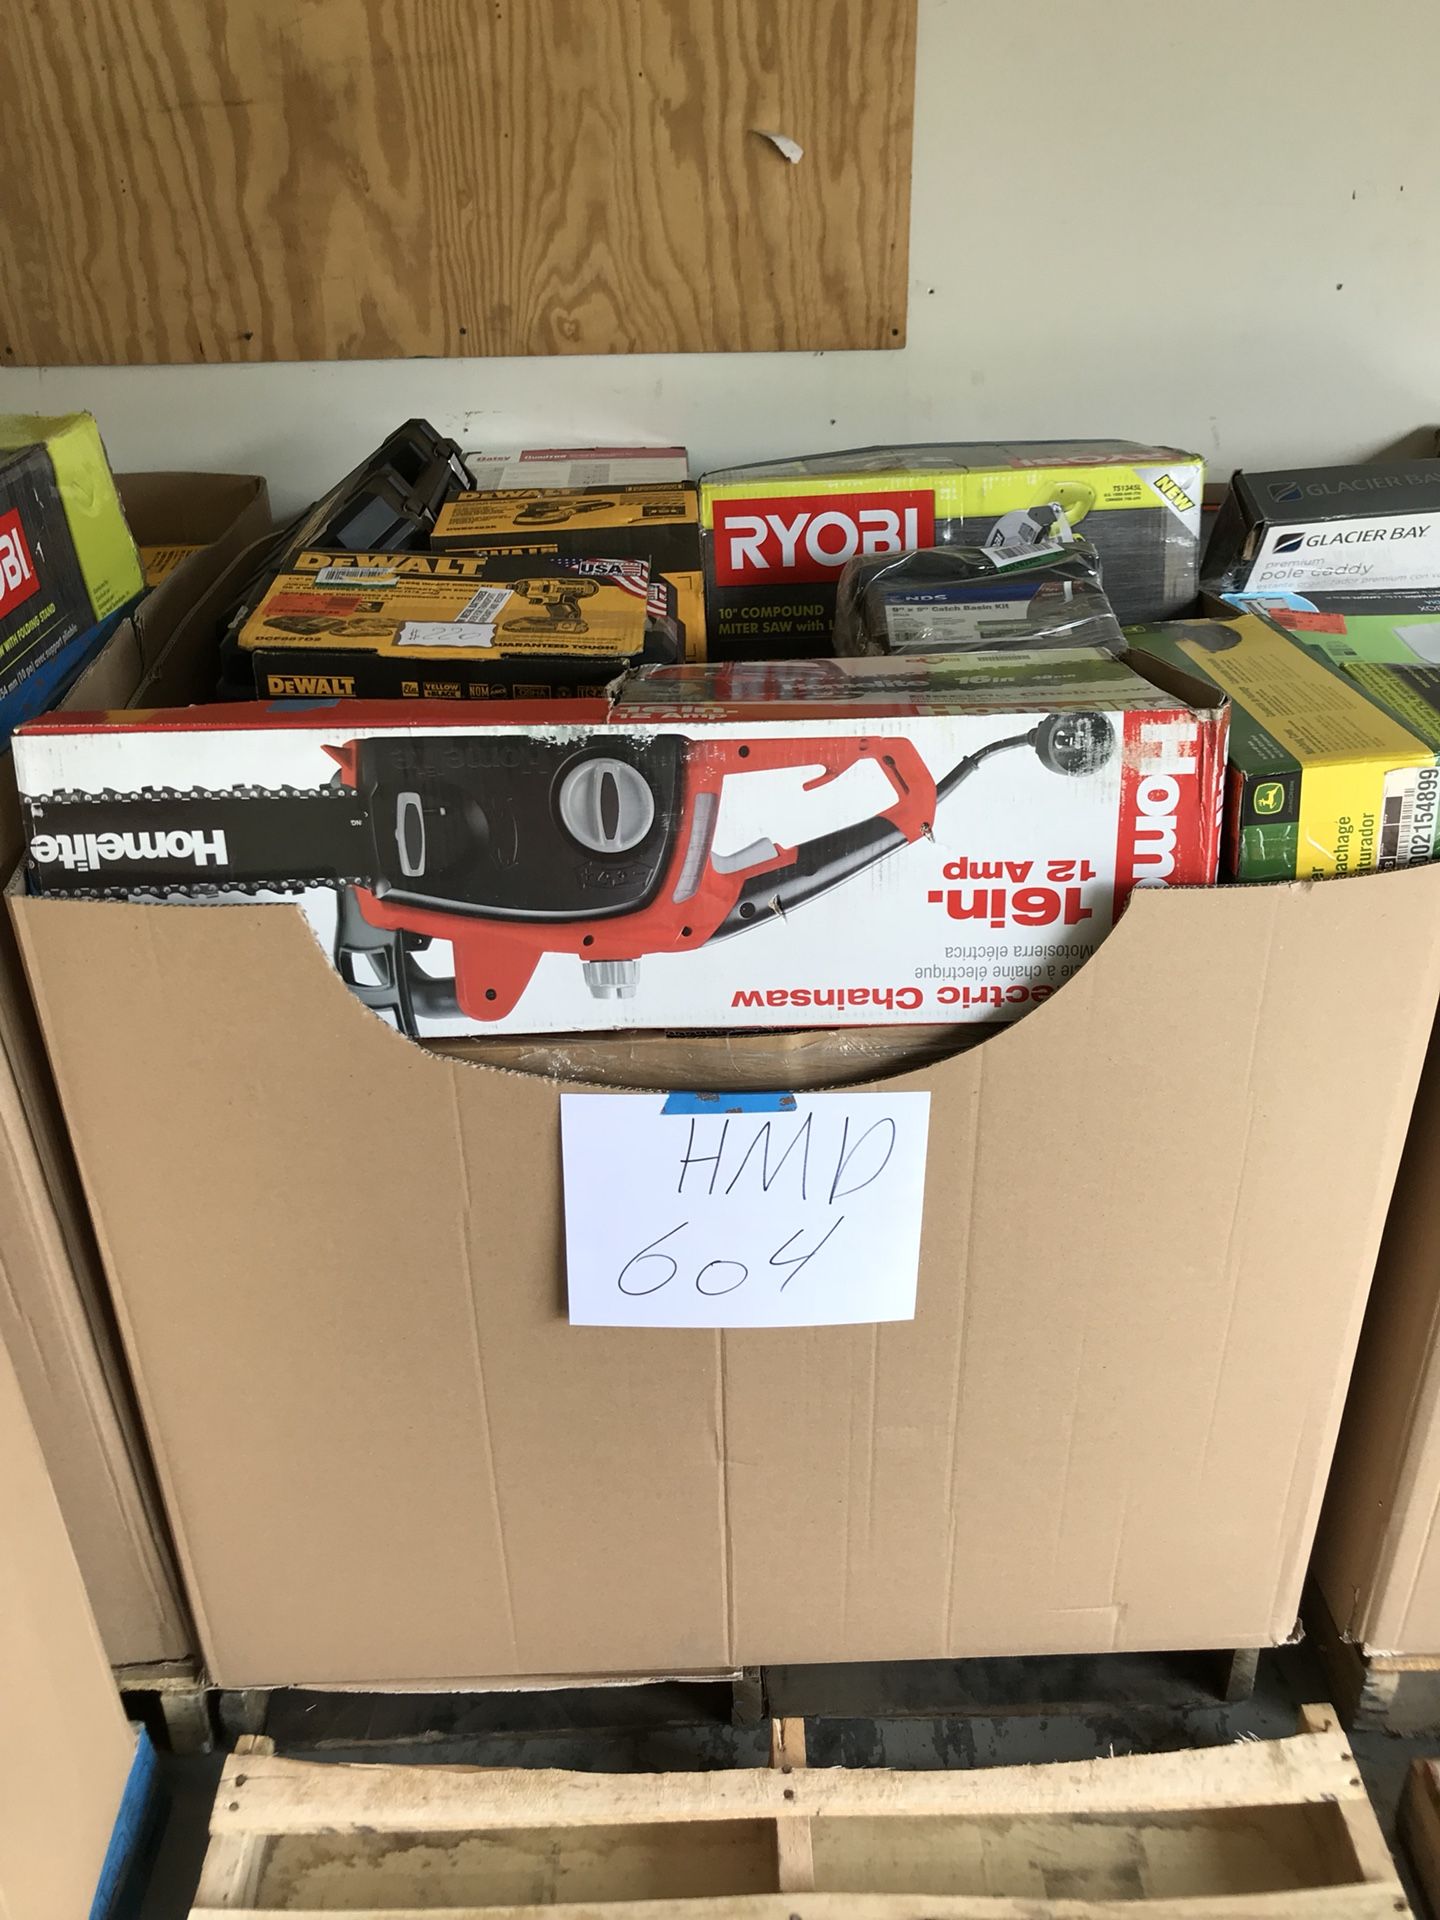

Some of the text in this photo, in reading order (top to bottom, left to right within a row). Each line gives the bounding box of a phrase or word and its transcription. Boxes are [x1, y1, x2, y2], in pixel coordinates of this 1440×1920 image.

[1153, 473, 1196, 512] NEW
[1306, 475, 1401, 497] GLACIER
[723, 507, 919, 570] RYOBI
[1306, 525, 1431, 548] GLACIER BAY
[293, 551, 488, 577] DEWALT
[580, 563, 623, 574] USA
[1259, 562, 1374, 581] pole caddy
[1265, 557, 1325, 570] premium
[718, 604, 825, 620] 10" COMPOUND
[931, 604, 961, 612] Catch
[17, 616, 41, 642] FOLDING
[39, 602, 56, 623] STAND
[718, 623, 759, 635] MITER
[762, 621, 793, 633] SAW
[796, 619, 824, 632] with
[267, 675, 357, 697] DEWALT
[424, 683, 459, 691] YELLOW
[469, 684, 489, 697] NOM
[31, 829, 228, 873] Homelite
[1355, 812, 1375, 872] iturador
[943, 857, 1096, 883] 12 Amp
[927, 887, 1093, 929] 16in.
[945, 944, 1095, 960] Motosierra eléctrica
[915, 964, 987, 981] électrique
[993, 965, 1042, 981] chaîne
[1047, 965, 1056, 979] à
[731, 985, 1055, 1011] ectric Chainsaw
[679, 1112, 896, 1205] HMD
[618, 1215, 845, 1296] 604
